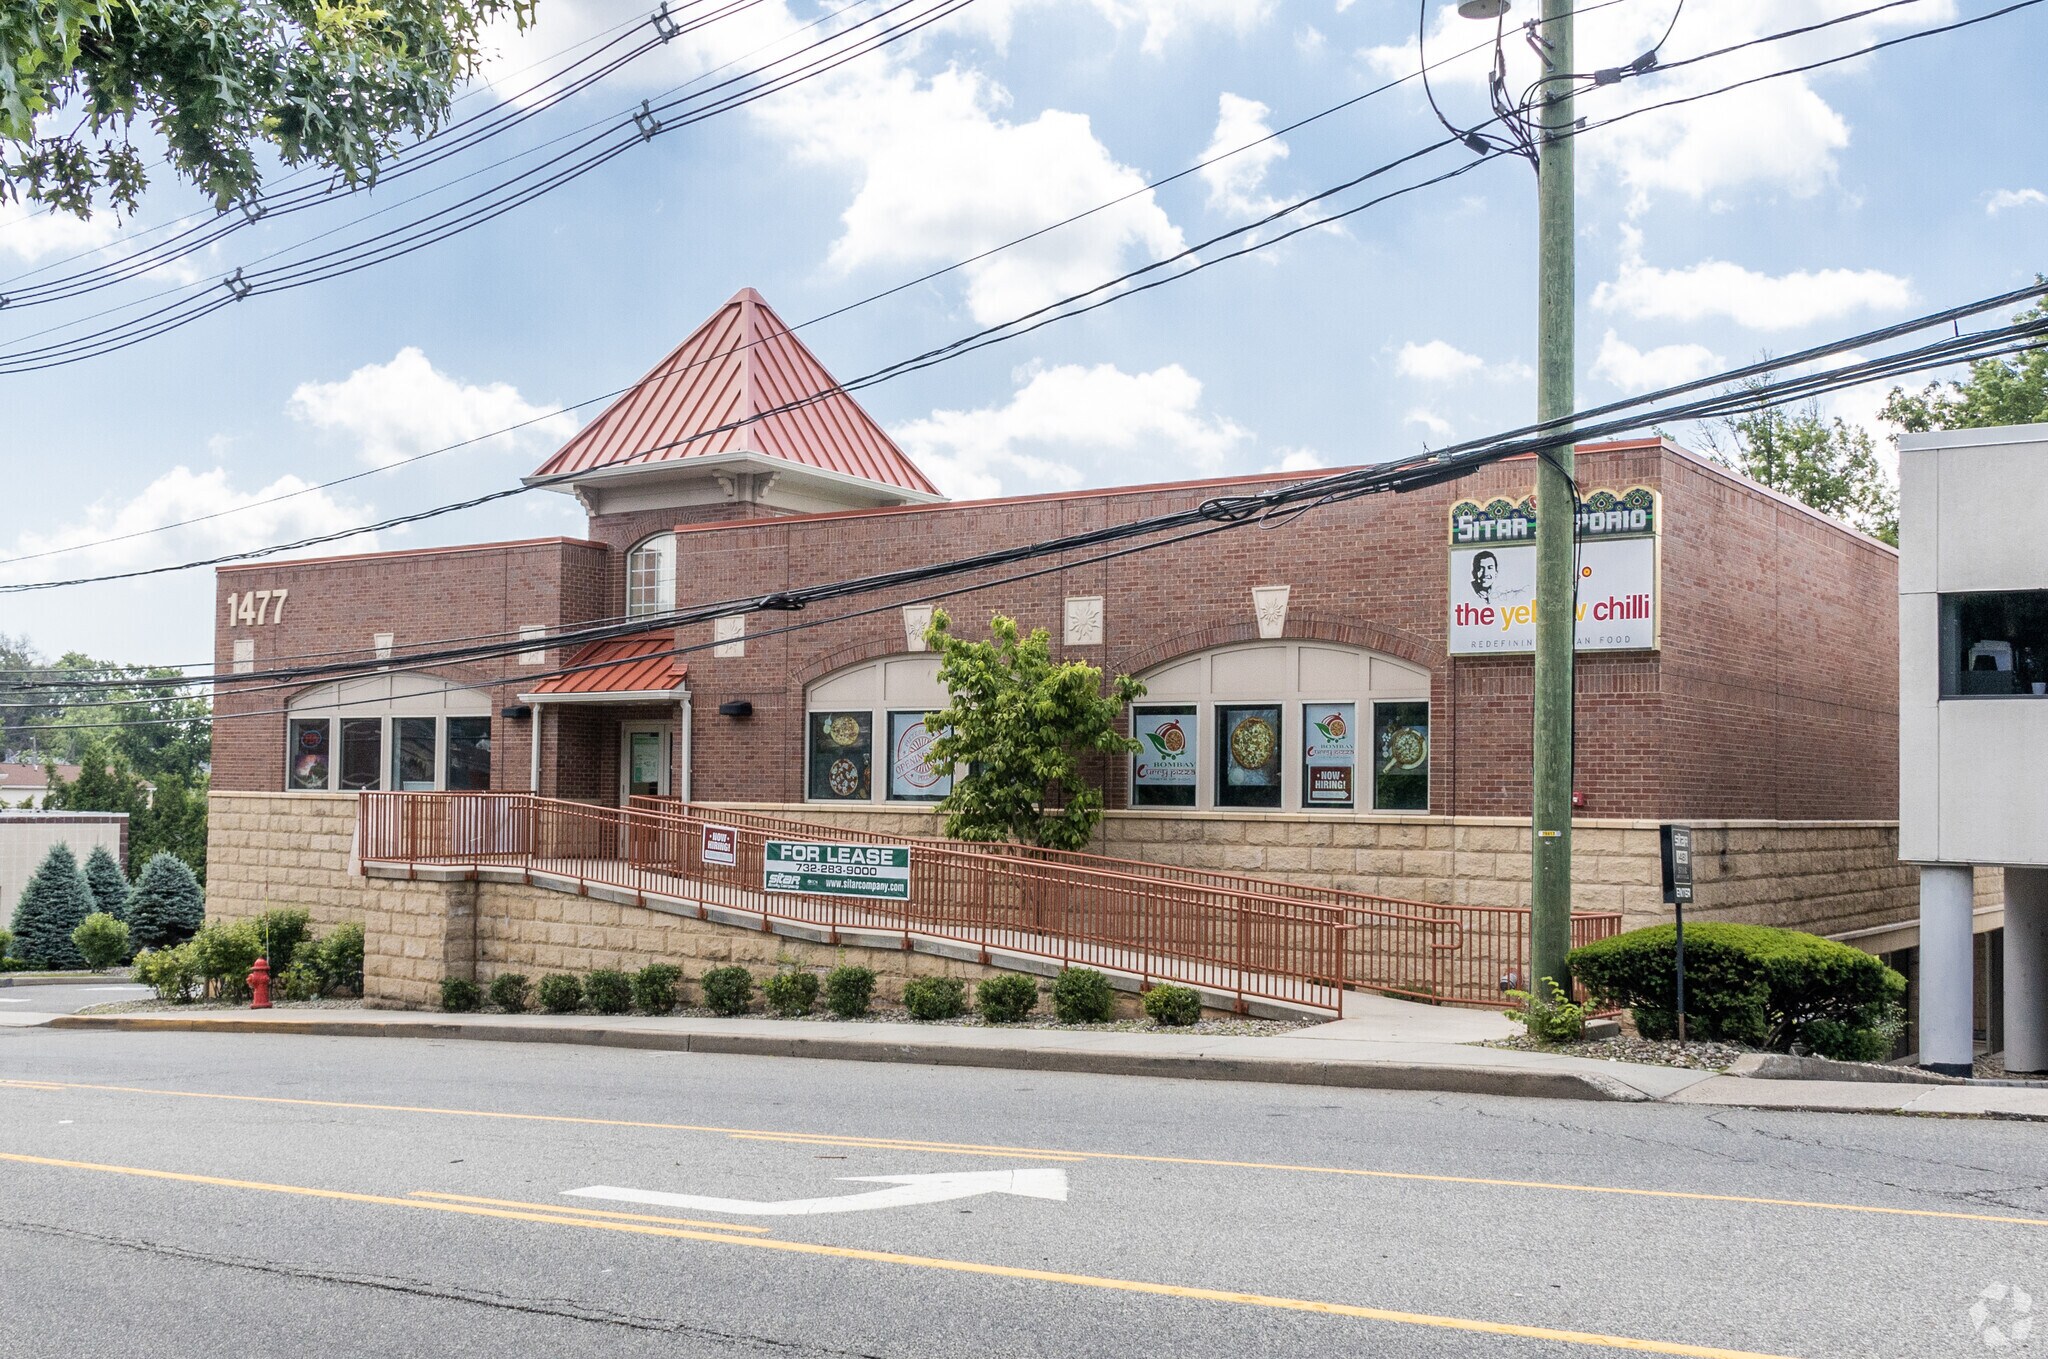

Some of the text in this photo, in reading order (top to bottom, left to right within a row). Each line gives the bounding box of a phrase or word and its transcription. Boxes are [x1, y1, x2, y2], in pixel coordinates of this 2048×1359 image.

[1458, 508, 1646, 541] SITAR PORIO
[227, 589, 288, 627] 1477
[1454, 594, 1650, 631] the yelw chilli
[1471, 639, 1534, 648] REDEFININ
[1599, 635, 1631, 645] FOOD
[1320, 771, 1340, 780] NOW
[1315, 780, 1346, 789] HIRING!
[780, 844, 894, 865] FOR LEASE
[826, 878, 905, 892] www.sitarcompany.com
